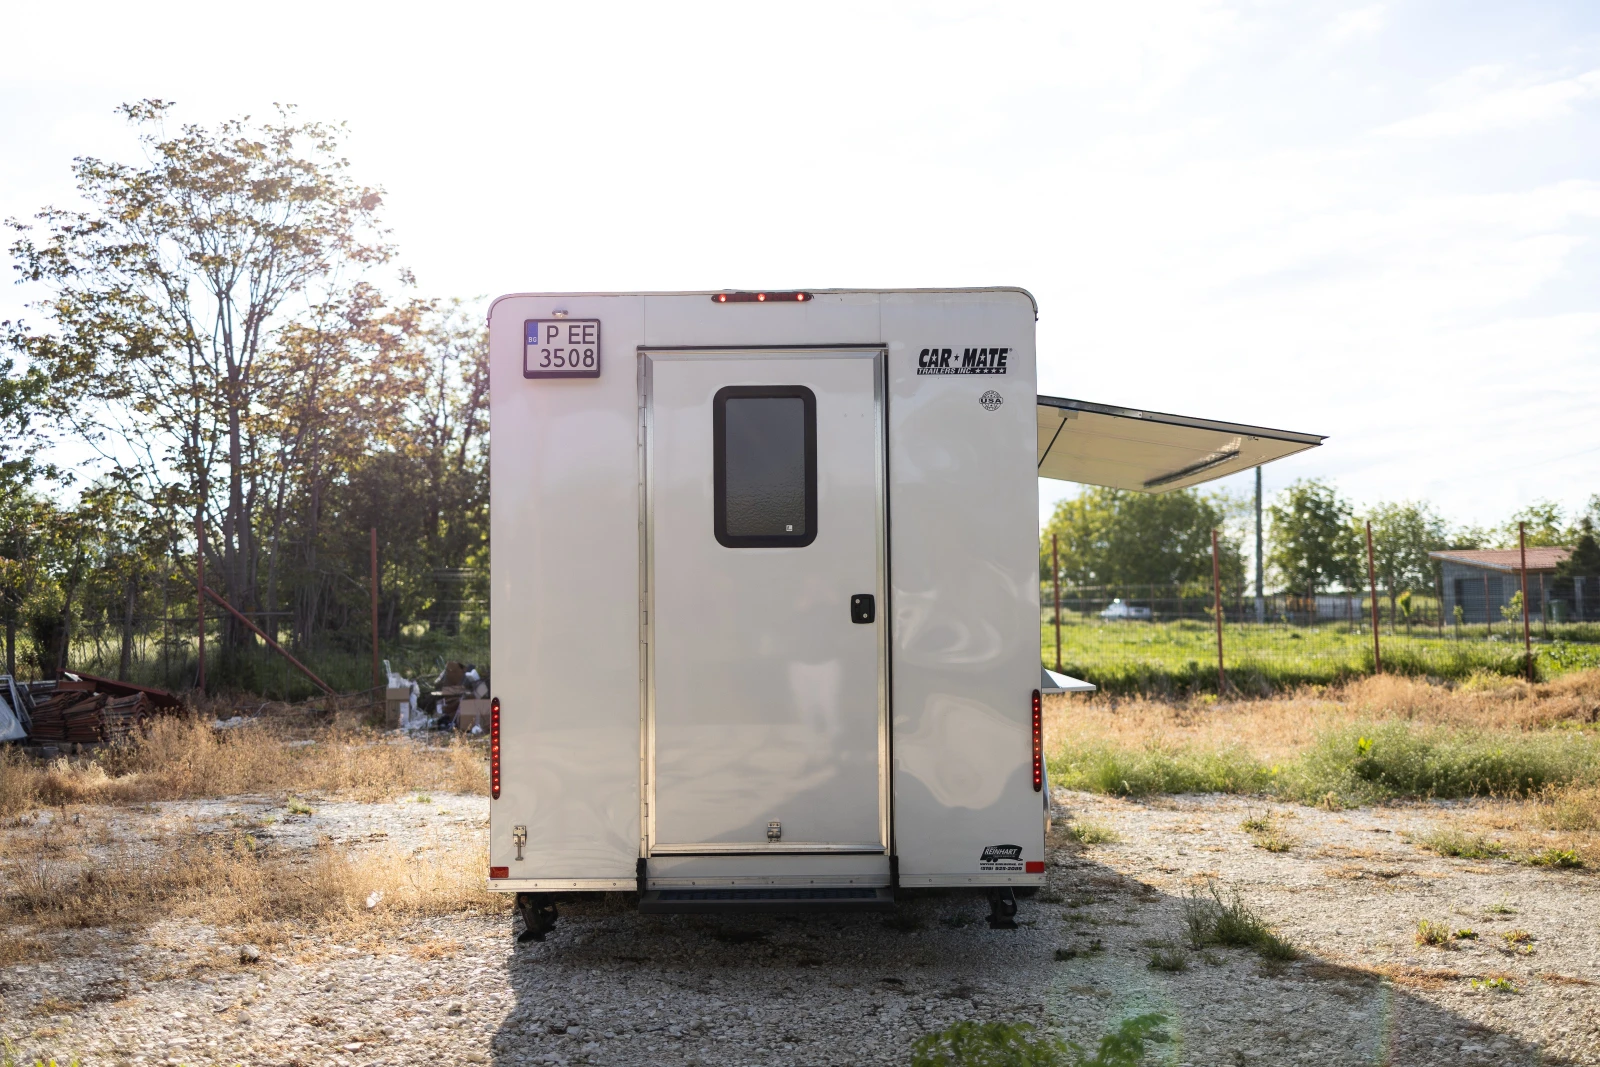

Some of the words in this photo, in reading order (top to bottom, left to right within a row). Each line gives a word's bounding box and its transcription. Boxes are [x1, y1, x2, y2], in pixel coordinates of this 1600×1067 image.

[546, 325, 559, 345] P
[568, 325, 595, 345] EE
[539, 348, 595, 368] 3508
[918, 348, 952, 368] CAR
[919, 367, 956, 375] TRAILERS
